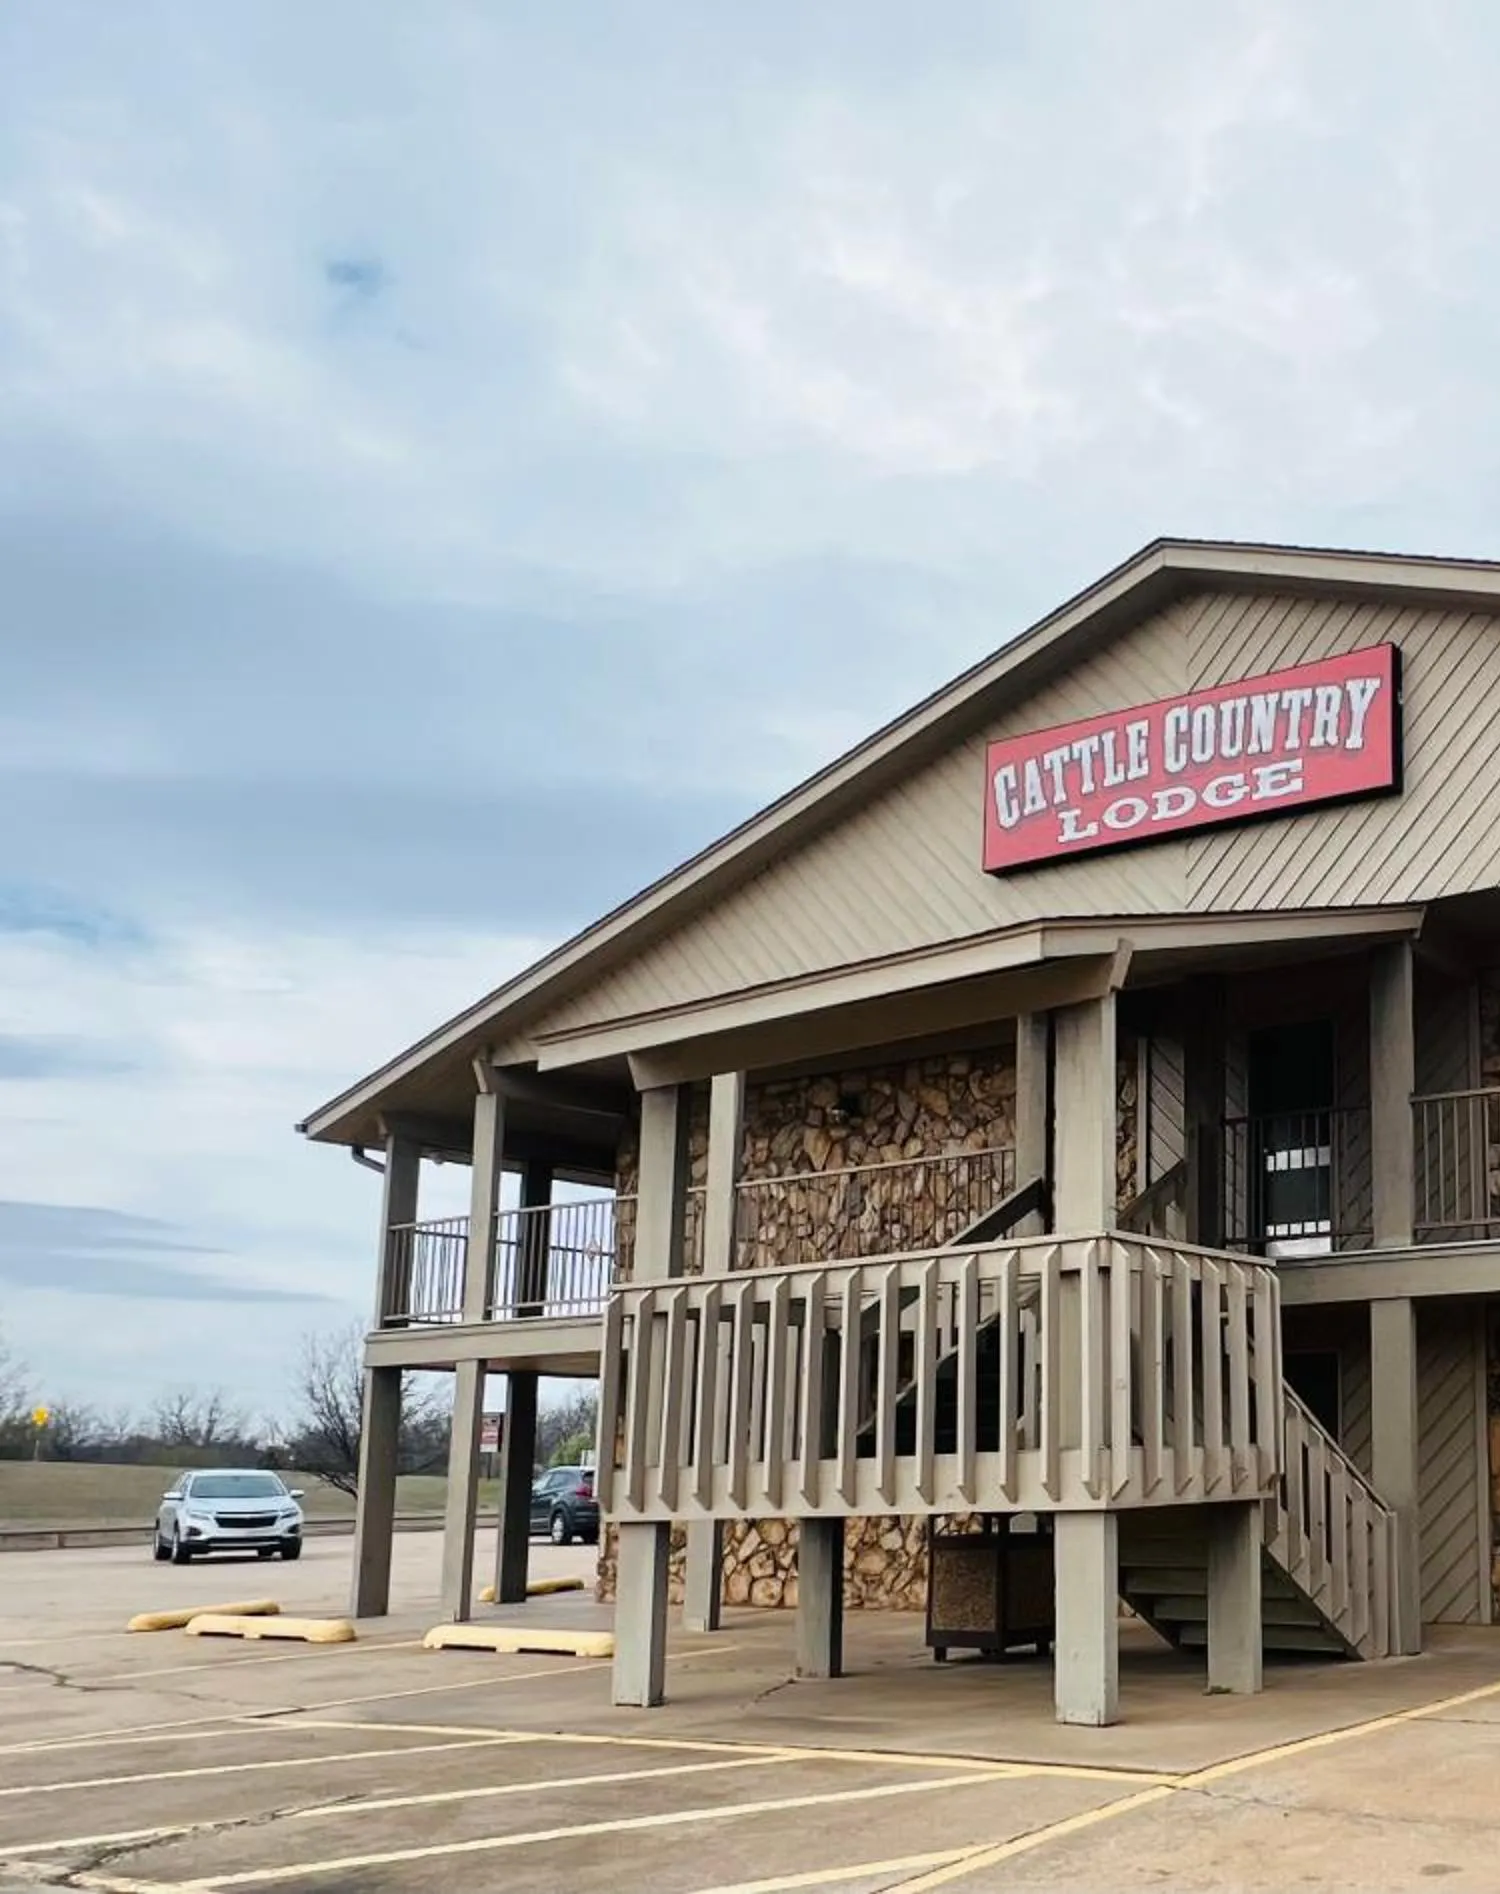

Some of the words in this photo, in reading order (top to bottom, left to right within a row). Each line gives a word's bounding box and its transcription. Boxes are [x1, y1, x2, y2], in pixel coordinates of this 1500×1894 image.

[993, 719, 1150, 830] CATTLE
[1163, 676, 1381, 775] COUNTRY
[1057, 758, 1305, 844] LODGE
